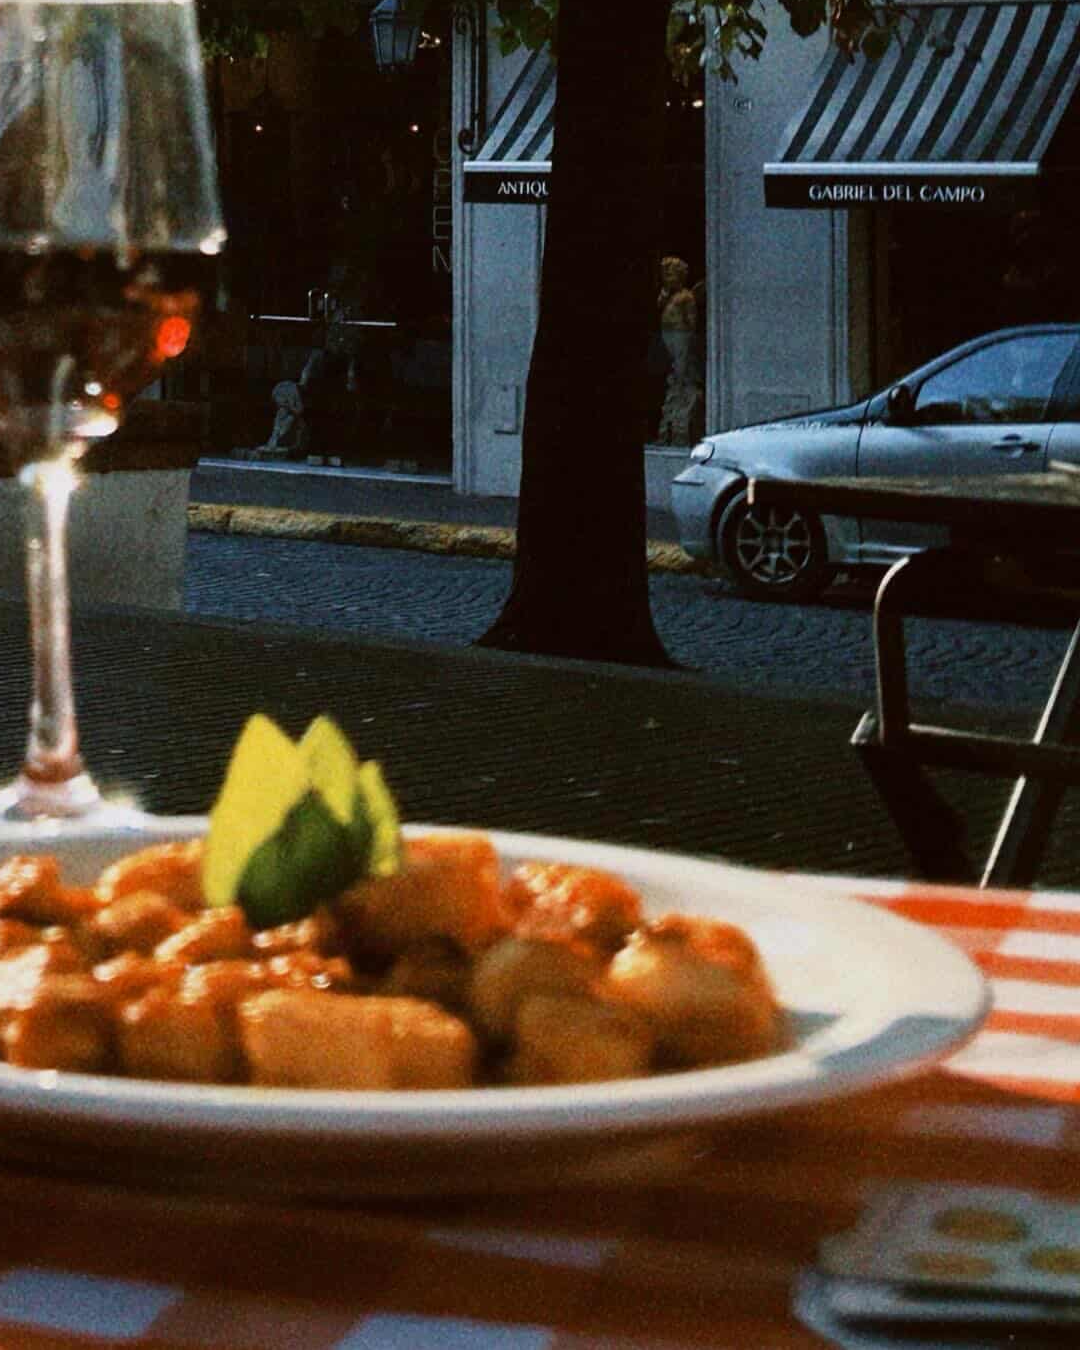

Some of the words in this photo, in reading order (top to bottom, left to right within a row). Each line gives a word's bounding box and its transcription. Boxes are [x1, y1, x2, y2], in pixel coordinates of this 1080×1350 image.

[808, 184, 876, 201] GABRIEL
[883, 184, 914, 201] DEL
[919, 185, 985, 202] CAMPO
